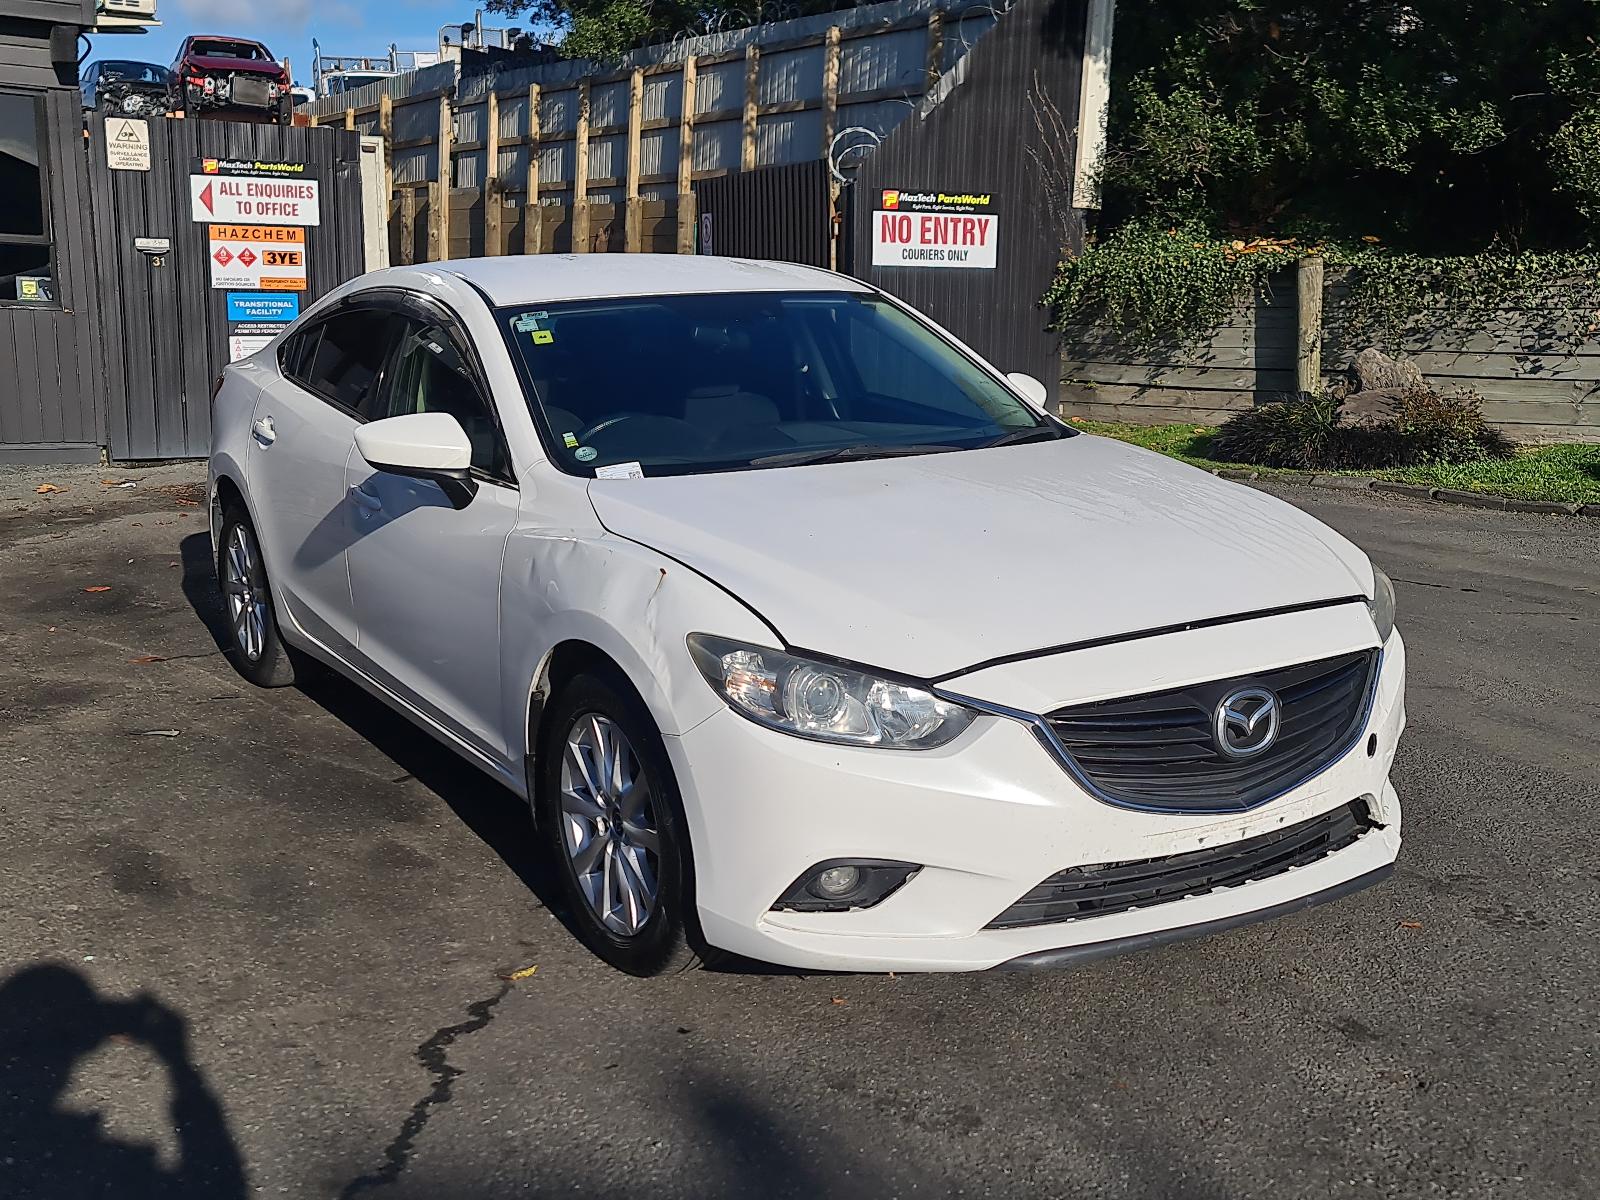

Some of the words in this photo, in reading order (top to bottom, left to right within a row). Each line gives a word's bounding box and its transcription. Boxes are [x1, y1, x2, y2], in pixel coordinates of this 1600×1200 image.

[109, 142, 148, 150] WARNING
[218, 161, 253, 169] MaxTech
[254, 162, 304, 172] PartsWorld
[220, 182, 243, 196] ALL
[247, 183, 314, 199] ENQUIRIES
[899, 192, 936, 203] MaxTech
[938, 194, 991, 205] PartsWorld
[236, 201, 252, 214] TO
[256, 202, 299, 216] OFFICE
[218, 228, 296, 240] HAZCHEM
[881, 214, 912, 243] NO
[920, 216, 990, 246] ENTRY
[267, 252, 299, 264] 3YE
[902, 248, 944, 260] COURIERS
[948, 250, 968, 261] ONLY
[152, 256, 166, 267] 31
